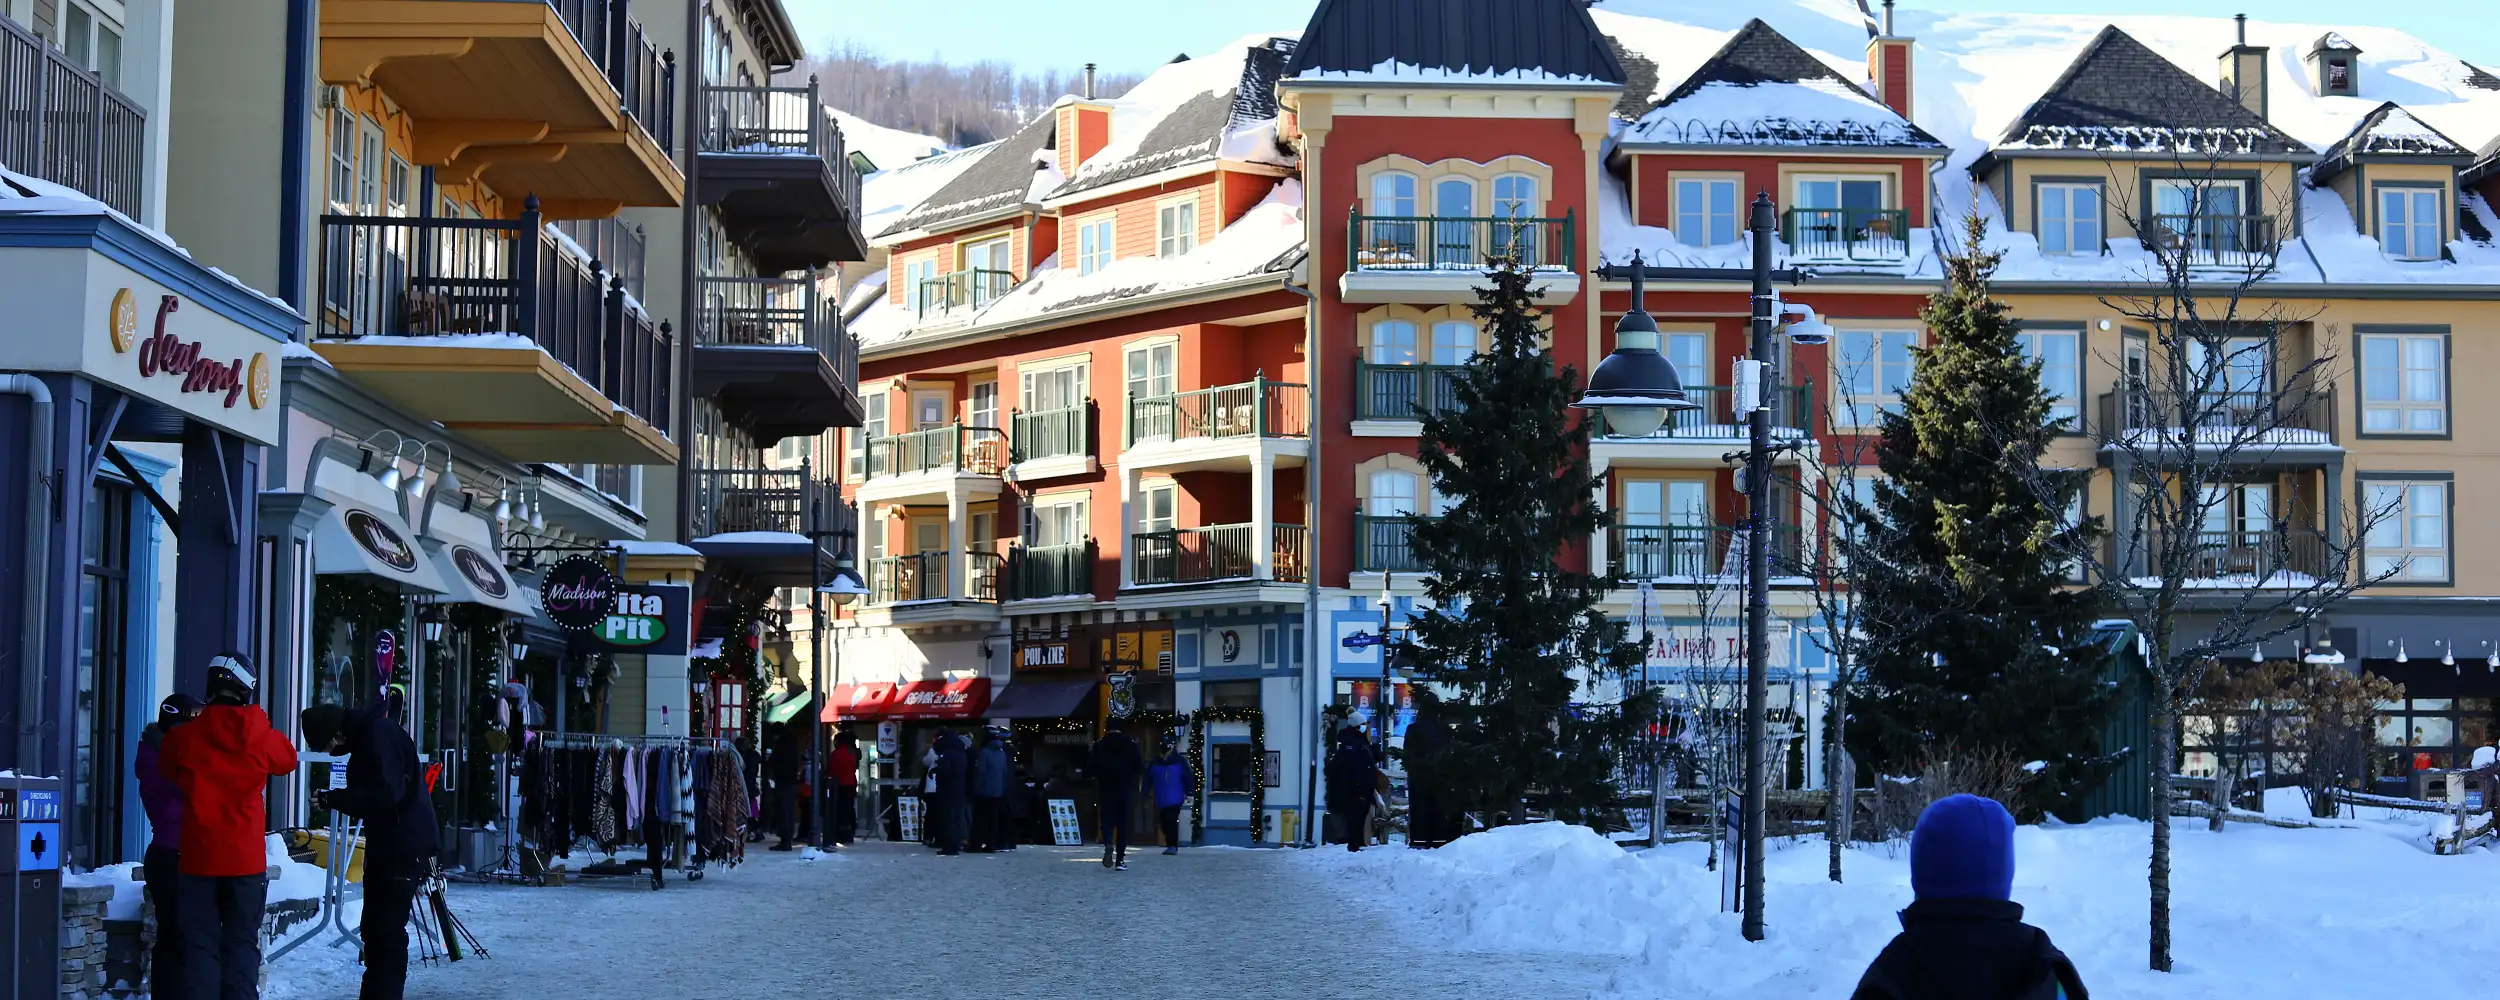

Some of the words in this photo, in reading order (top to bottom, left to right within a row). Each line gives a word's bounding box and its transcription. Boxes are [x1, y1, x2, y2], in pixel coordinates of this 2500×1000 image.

[139, 295, 243, 408] Seasons
[549, 583, 607, 601] Madison
[614, 592, 663, 616] ita
[605, 615, 652, 640] Pit
[1647, 638, 1716, 659] AMINO
[933, 694, 944, 704] at
[944, 690, 968, 704] Blue
[1360, 696, 1369, 707] B
[1403, 696, 1412, 708] B
